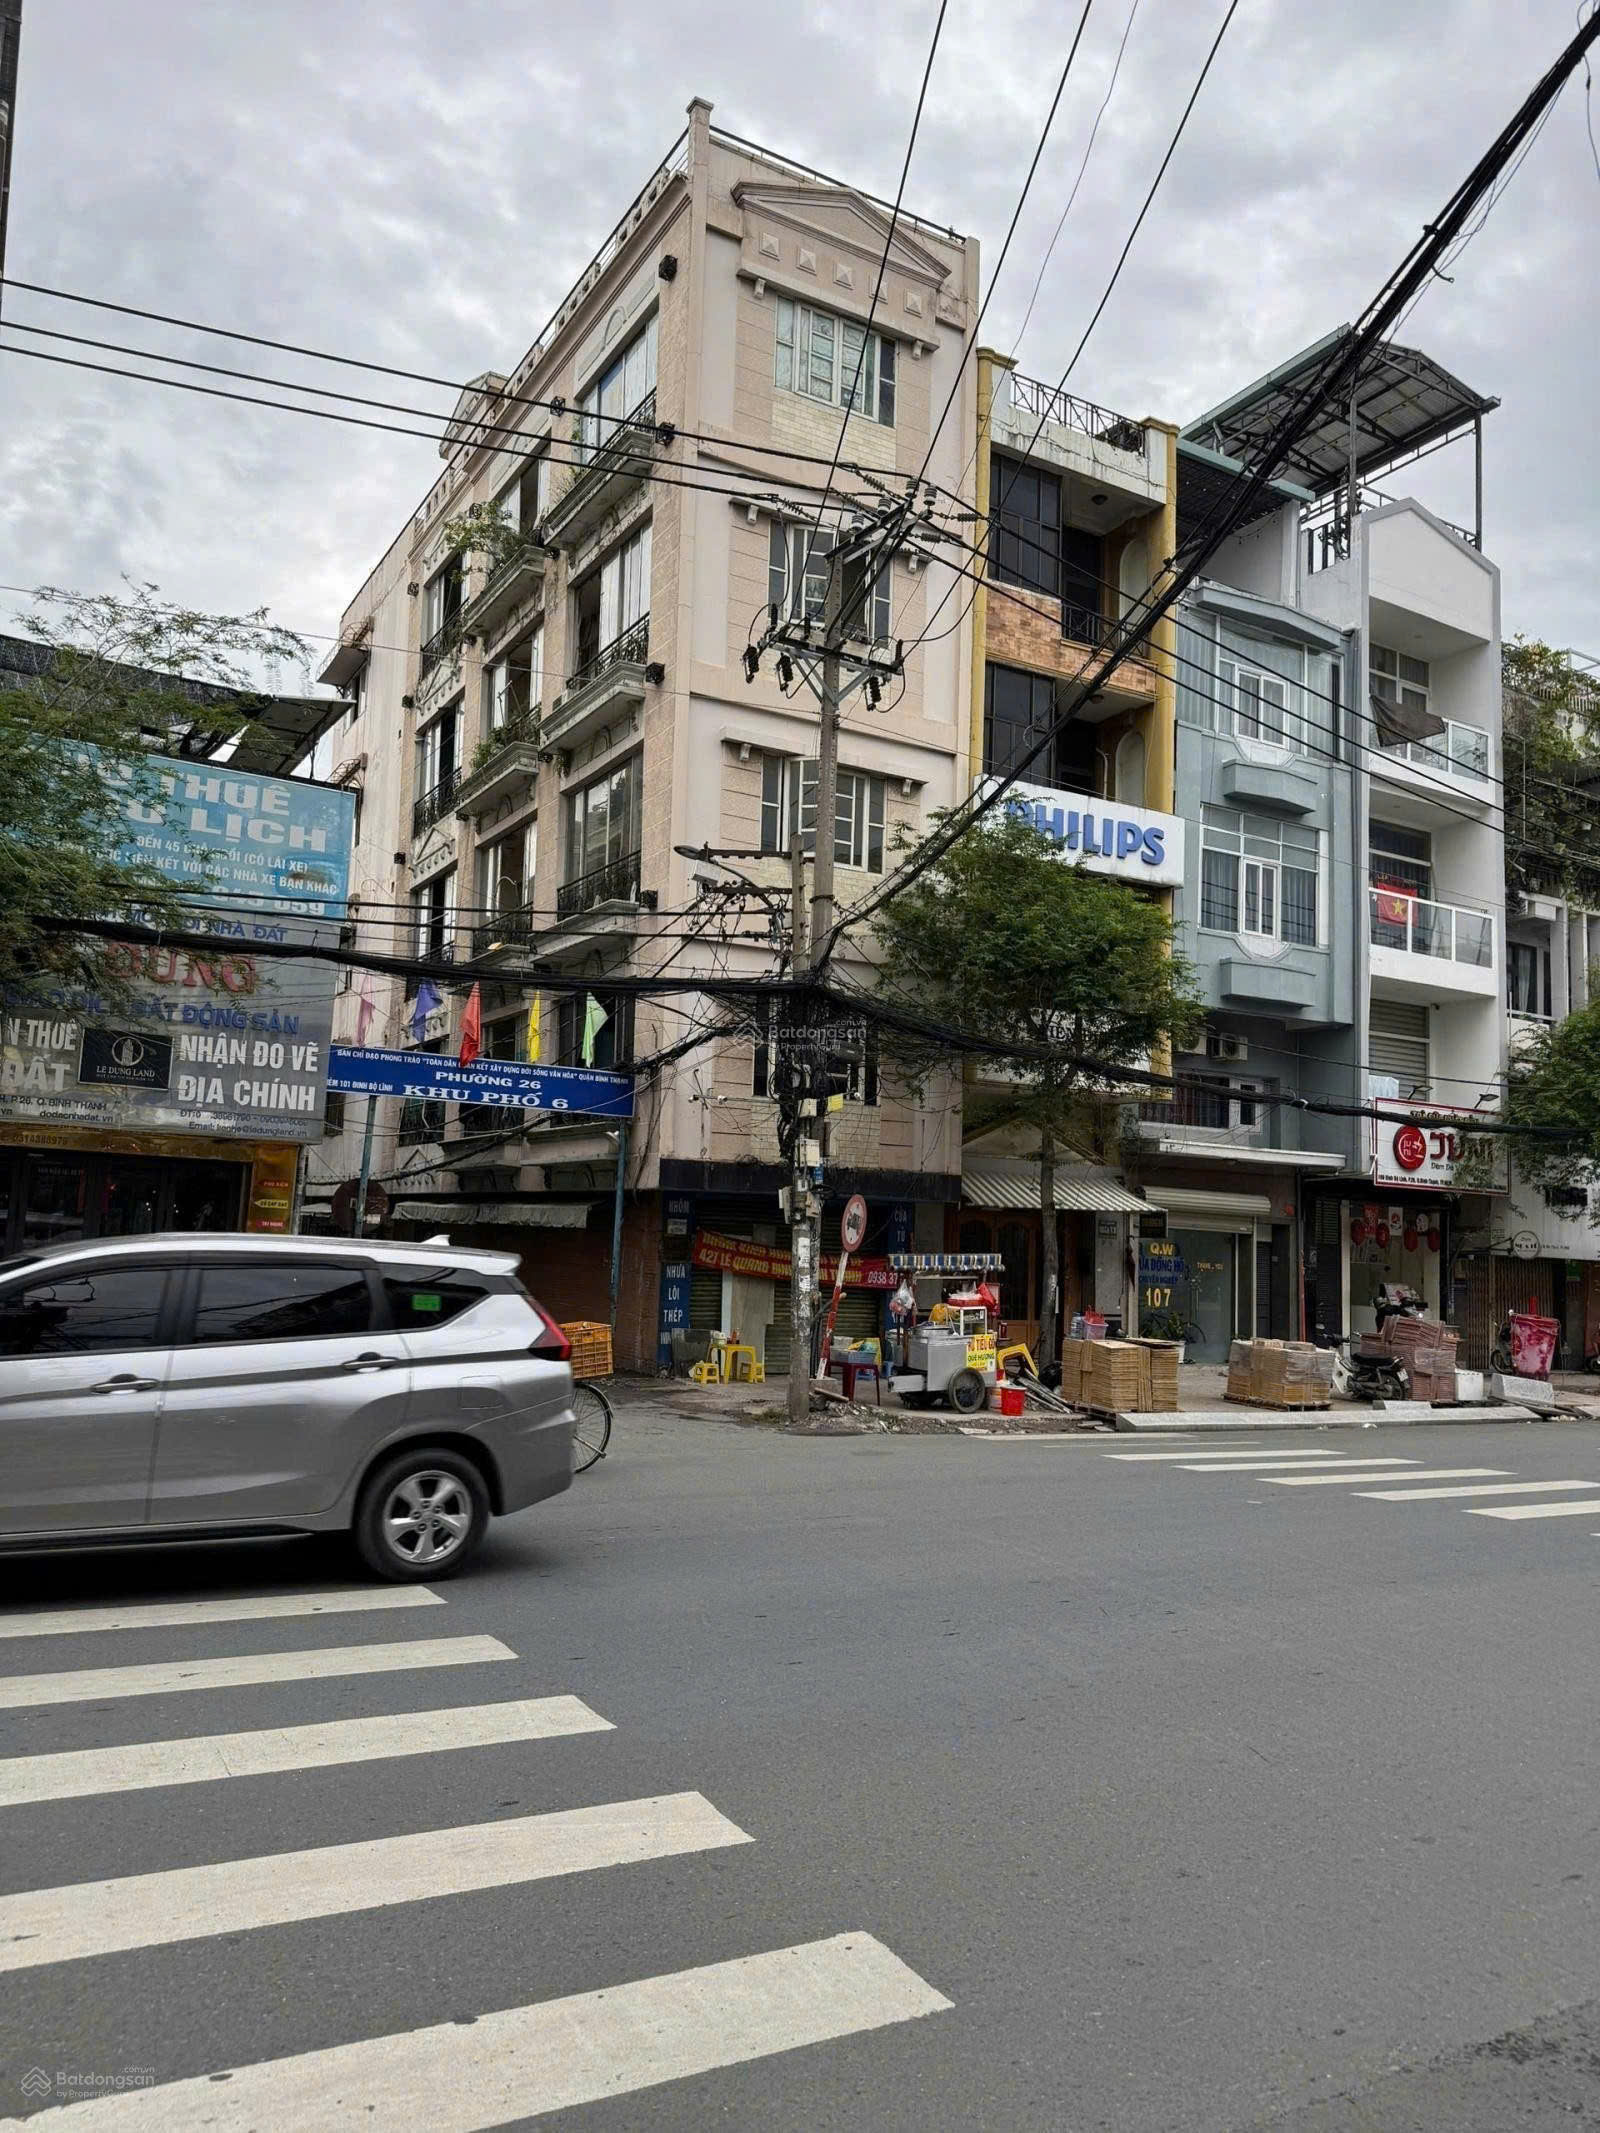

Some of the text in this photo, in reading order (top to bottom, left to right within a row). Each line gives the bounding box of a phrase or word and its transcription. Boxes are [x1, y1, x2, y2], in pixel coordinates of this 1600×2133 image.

[191, 808, 327, 853] LỊCH
[1007, 801, 1165, 866] PHILIPS
[165, 840, 180, 852] 45
[261, 873, 276, 886] XE
[182, 1003, 250, 1029] ĐỘNG
[26, 1017, 78, 1051] THUÊ
[179, 1032, 319, 1073] NHẬN ĐO VẼ
[337, 1049, 352, 1057] BAN
[381, 1053, 402, 1062] PHONG
[404, 1055, 421, 1064] TRÀO
[133, 1069, 156, 1079] LAND
[436, 1071, 541, 1089] PHƯỜNG 26
[178, 1075, 316, 1112] ĐỊA CHÍNH
[340, 1080, 351, 1088] 101
[402, 1084, 569, 1109] KHU PHỐ 6
[868, 1271, 887, 1286] 0938
[1147, 1287, 1171, 1307] 107
[663, 1306, 684, 1323] THÉP
